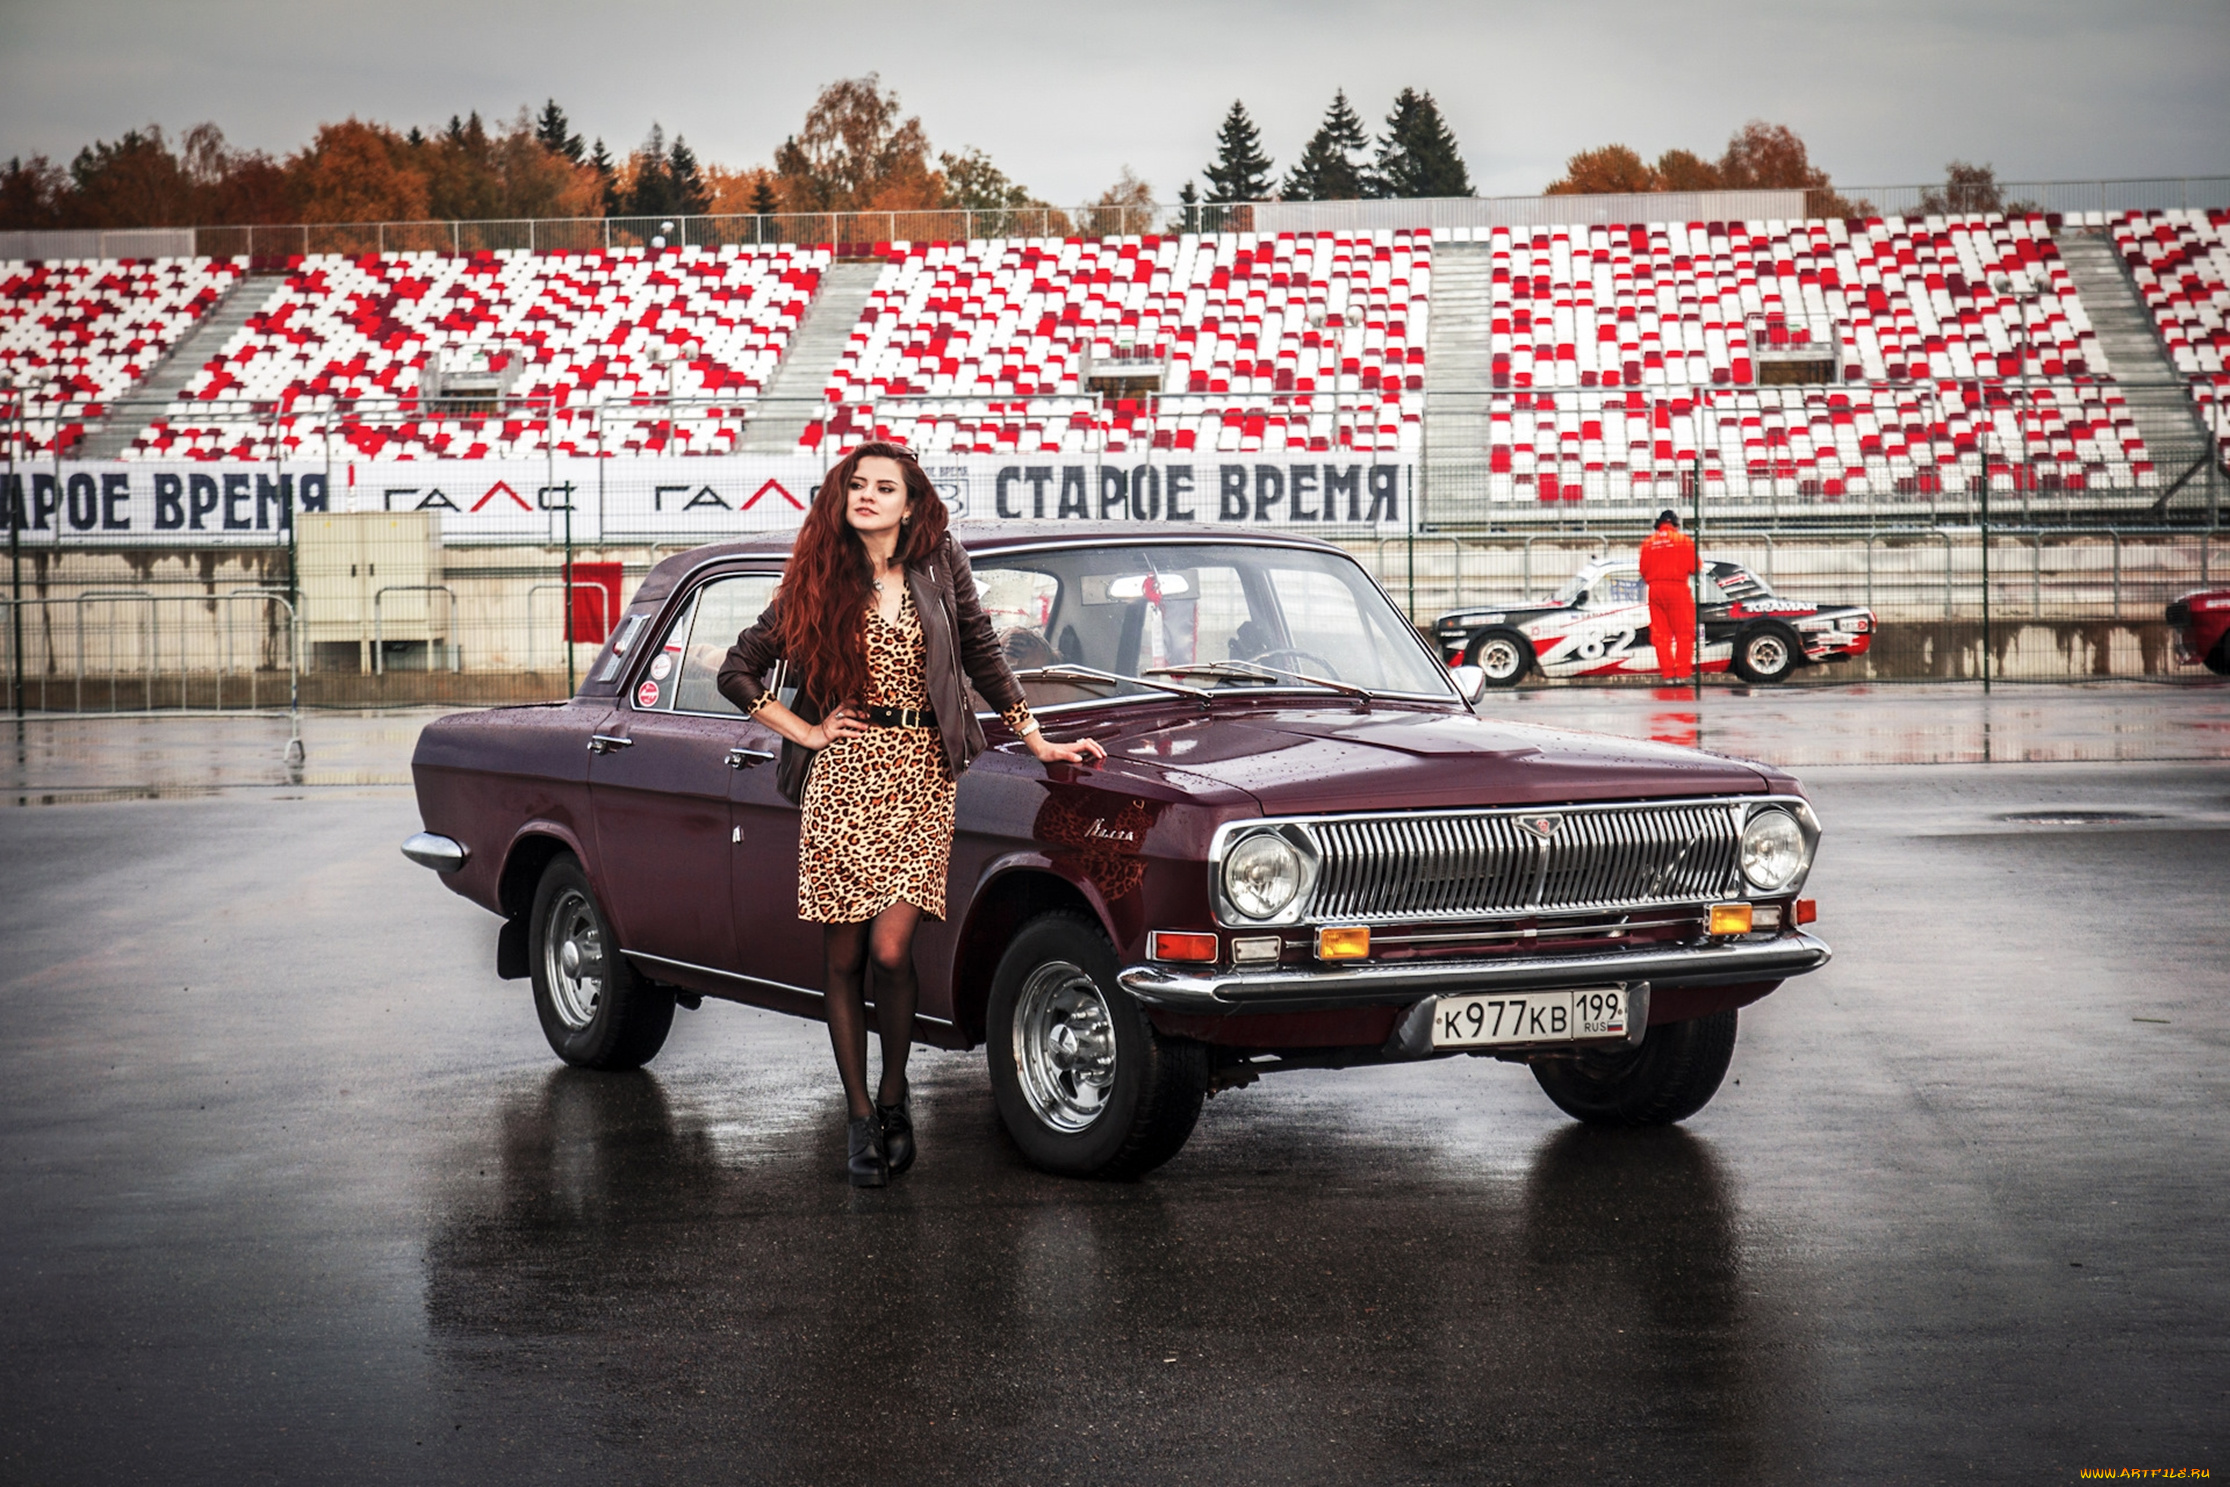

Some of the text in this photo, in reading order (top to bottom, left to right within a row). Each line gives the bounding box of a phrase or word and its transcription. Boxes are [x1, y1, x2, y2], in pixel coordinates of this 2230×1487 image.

[154, 473, 327, 530] ВРЕМЯ
[655, 478, 822, 511] ГАЛ
[996, 464, 1195, 521] СТАРОЕ
[1219, 464, 1400, 522] ВРЕМЯ
[1577, 624, 1638, 661] 82
[1445, 1000, 1567, 1039] К977КВ
[1576, 993, 1619, 1021] 199
[1584, 1022, 1606, 1032] RUS
